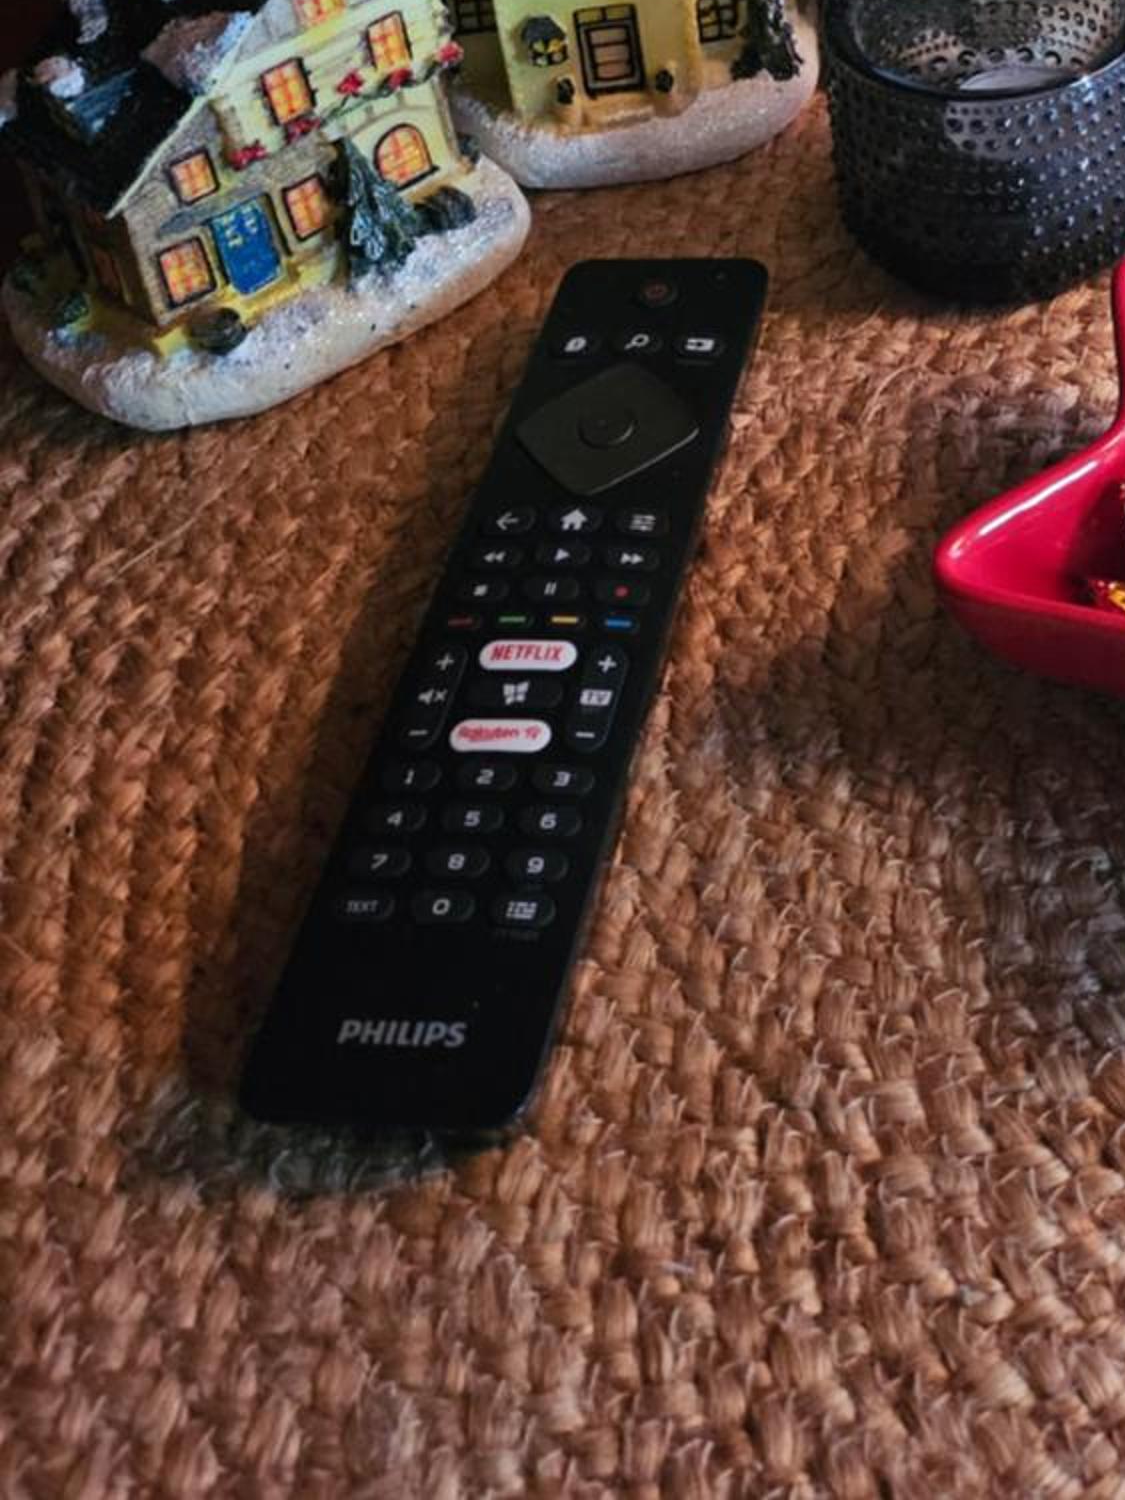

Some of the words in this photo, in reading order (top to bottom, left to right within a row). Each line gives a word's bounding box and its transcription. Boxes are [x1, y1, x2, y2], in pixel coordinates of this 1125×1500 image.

[489, 645, 564, 662] NETFLIX
[403, 769, 414, 785] 1
[476, 768, 495, 786] 2
[553, 771, 572, 787] 3
[387, 811, 403, 826] 4
[463, 810, 481, 827] 5
[539, 812, 557, 829] 6
[371, 853, 388, 870] 7
[447, 853, 466, 870] 8
[526, 856, 545, 873] 9
[337, 1019, 468, 1048] PHILIPS
